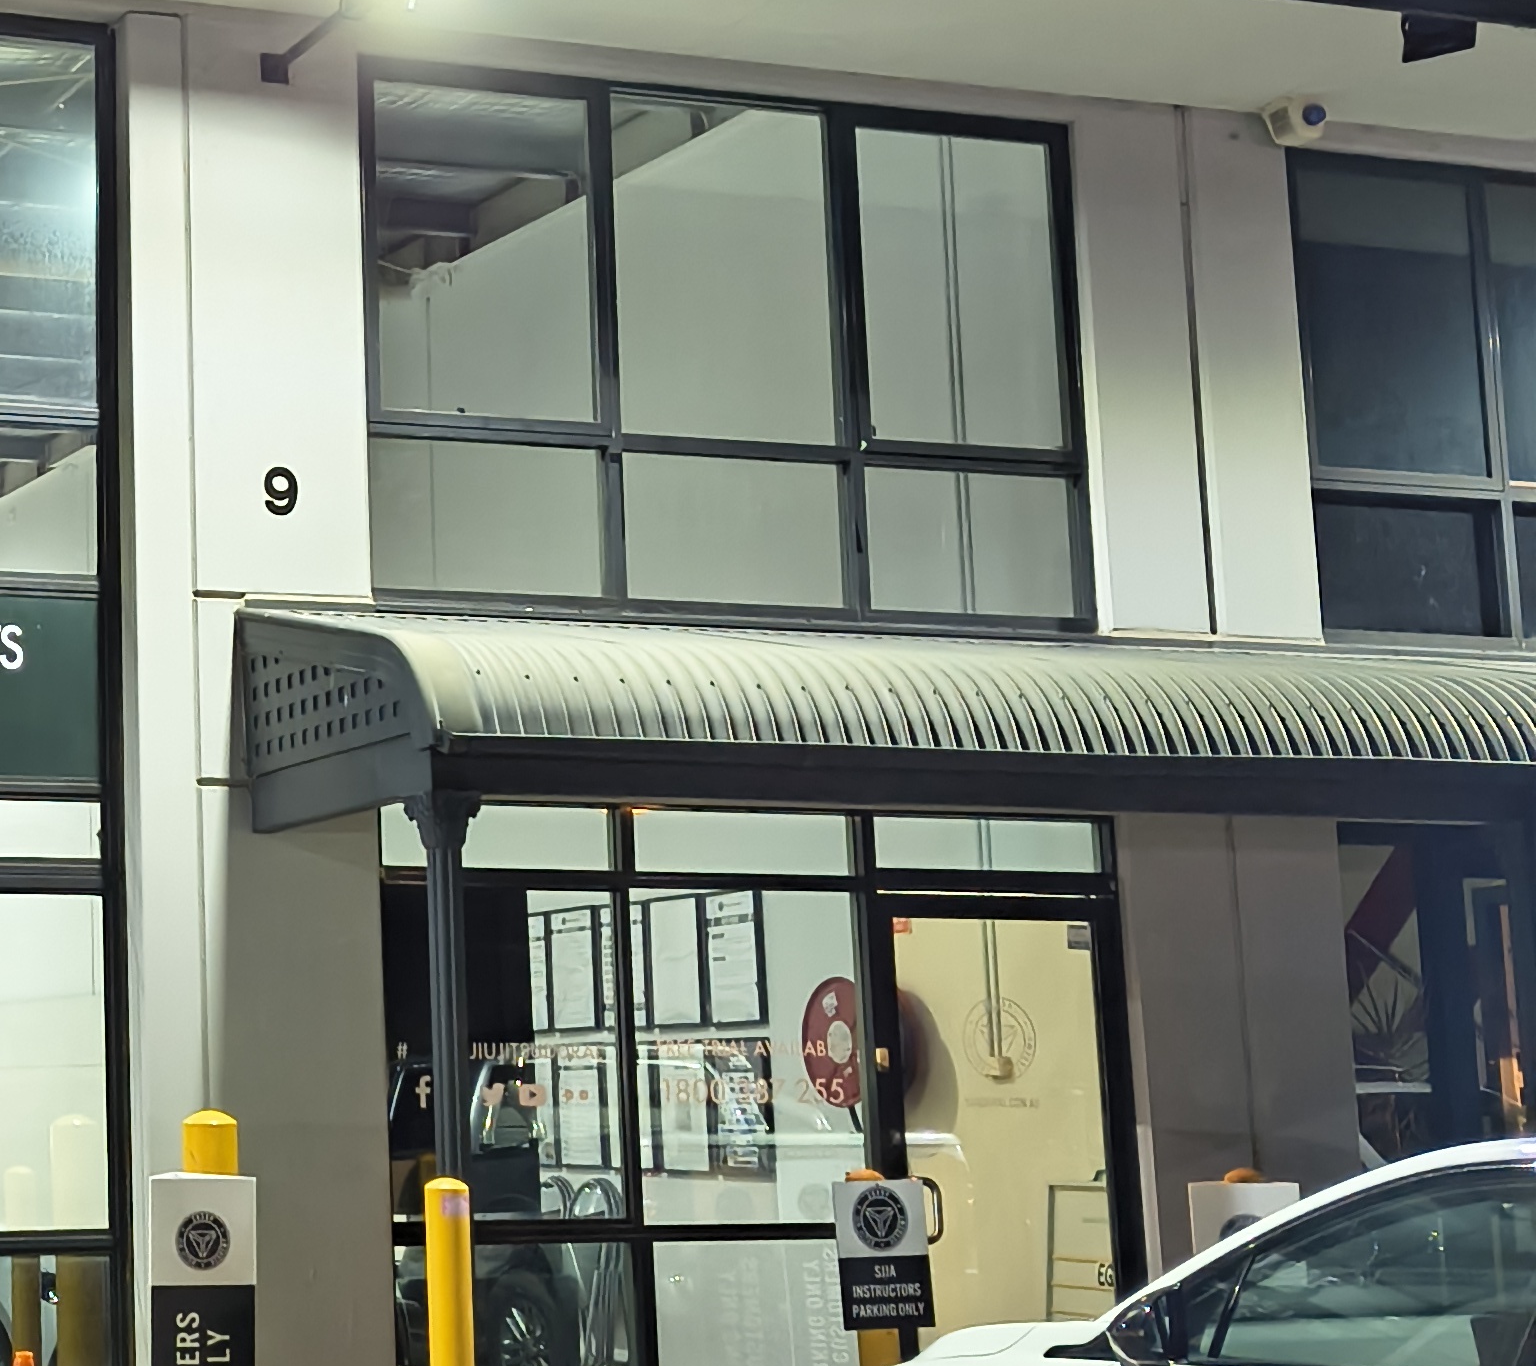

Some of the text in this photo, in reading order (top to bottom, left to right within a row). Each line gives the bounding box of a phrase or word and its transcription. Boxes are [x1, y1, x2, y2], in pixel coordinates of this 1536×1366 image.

[263, 466, 298, 516] 9
[852, 1282, 922, 1299] INSTRUCTORS
[852, 1302, 925, 1318] PARKING ONLY
